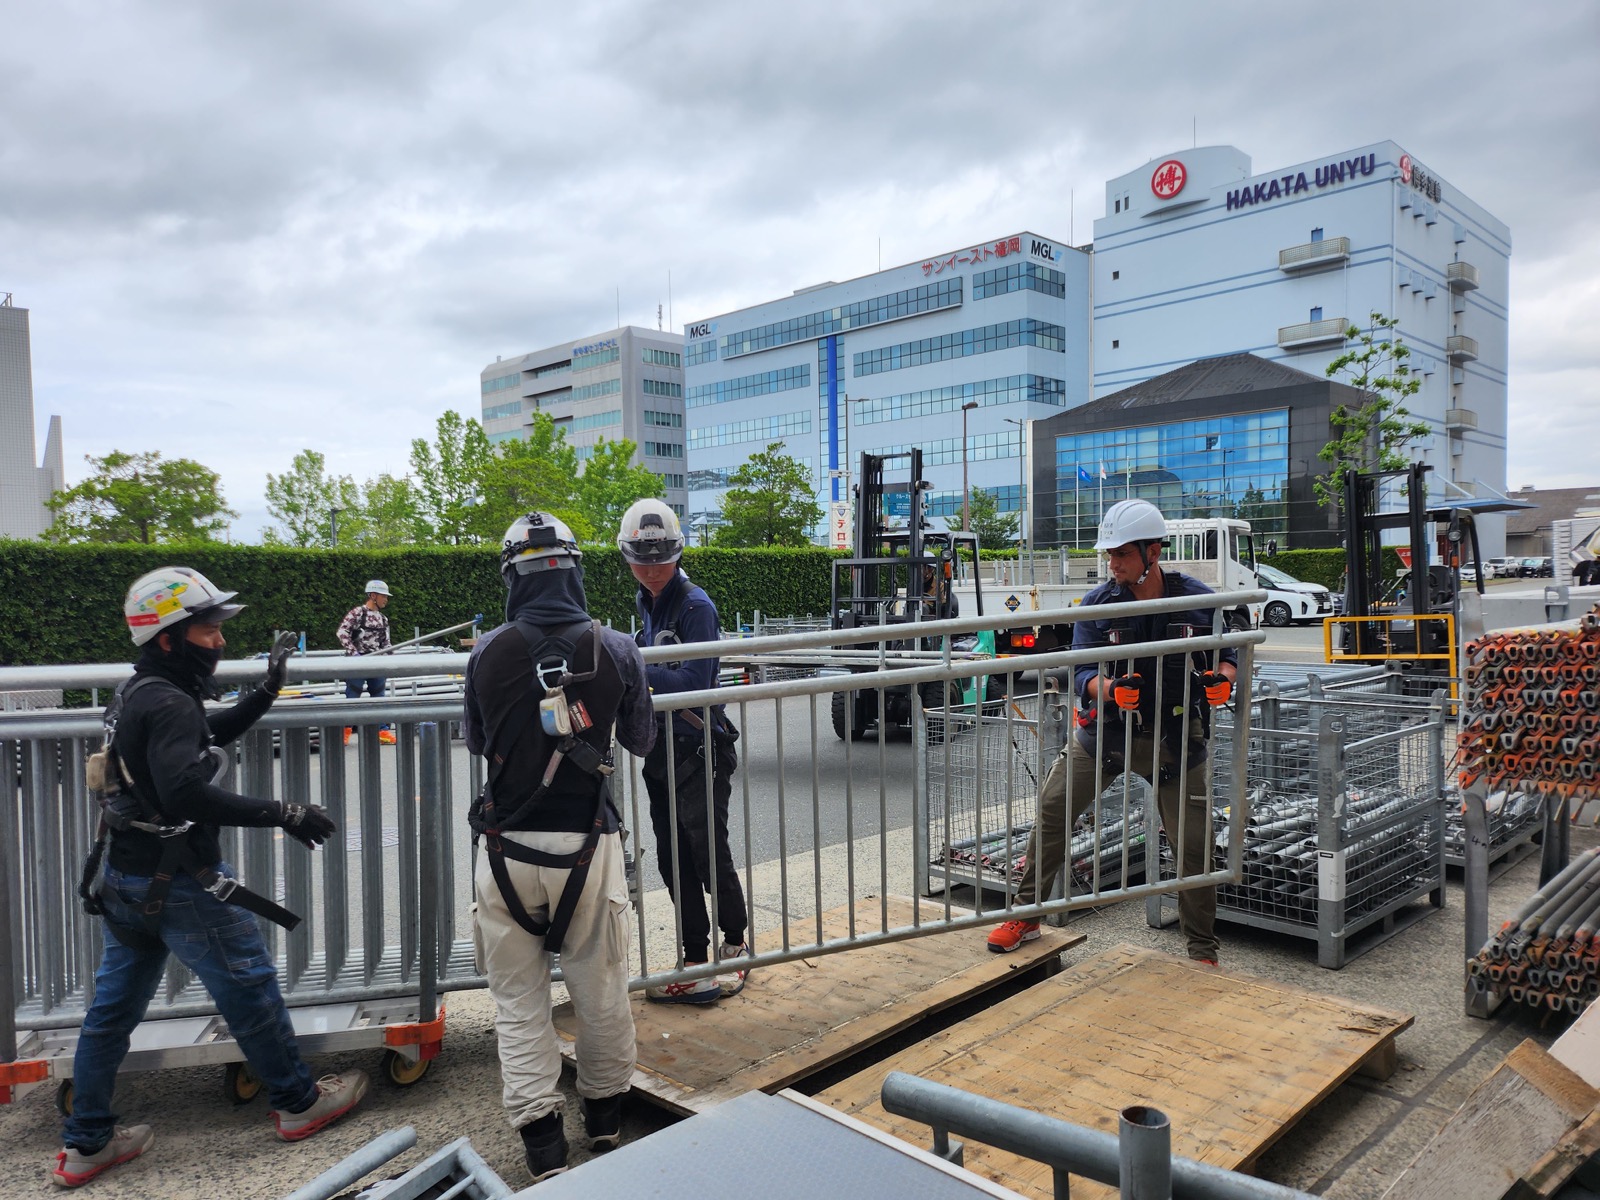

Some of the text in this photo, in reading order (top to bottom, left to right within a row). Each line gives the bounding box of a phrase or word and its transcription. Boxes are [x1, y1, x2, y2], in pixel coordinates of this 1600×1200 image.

[1226, 171, 1309, 211] HAKATA
[1315, 153, 1375, 188] UNYU
[921, 236, 1021, 277] サンイースト福岡
[1031, 239, 1055, 261] MGL
[690, 323, 711, 339] MGL
